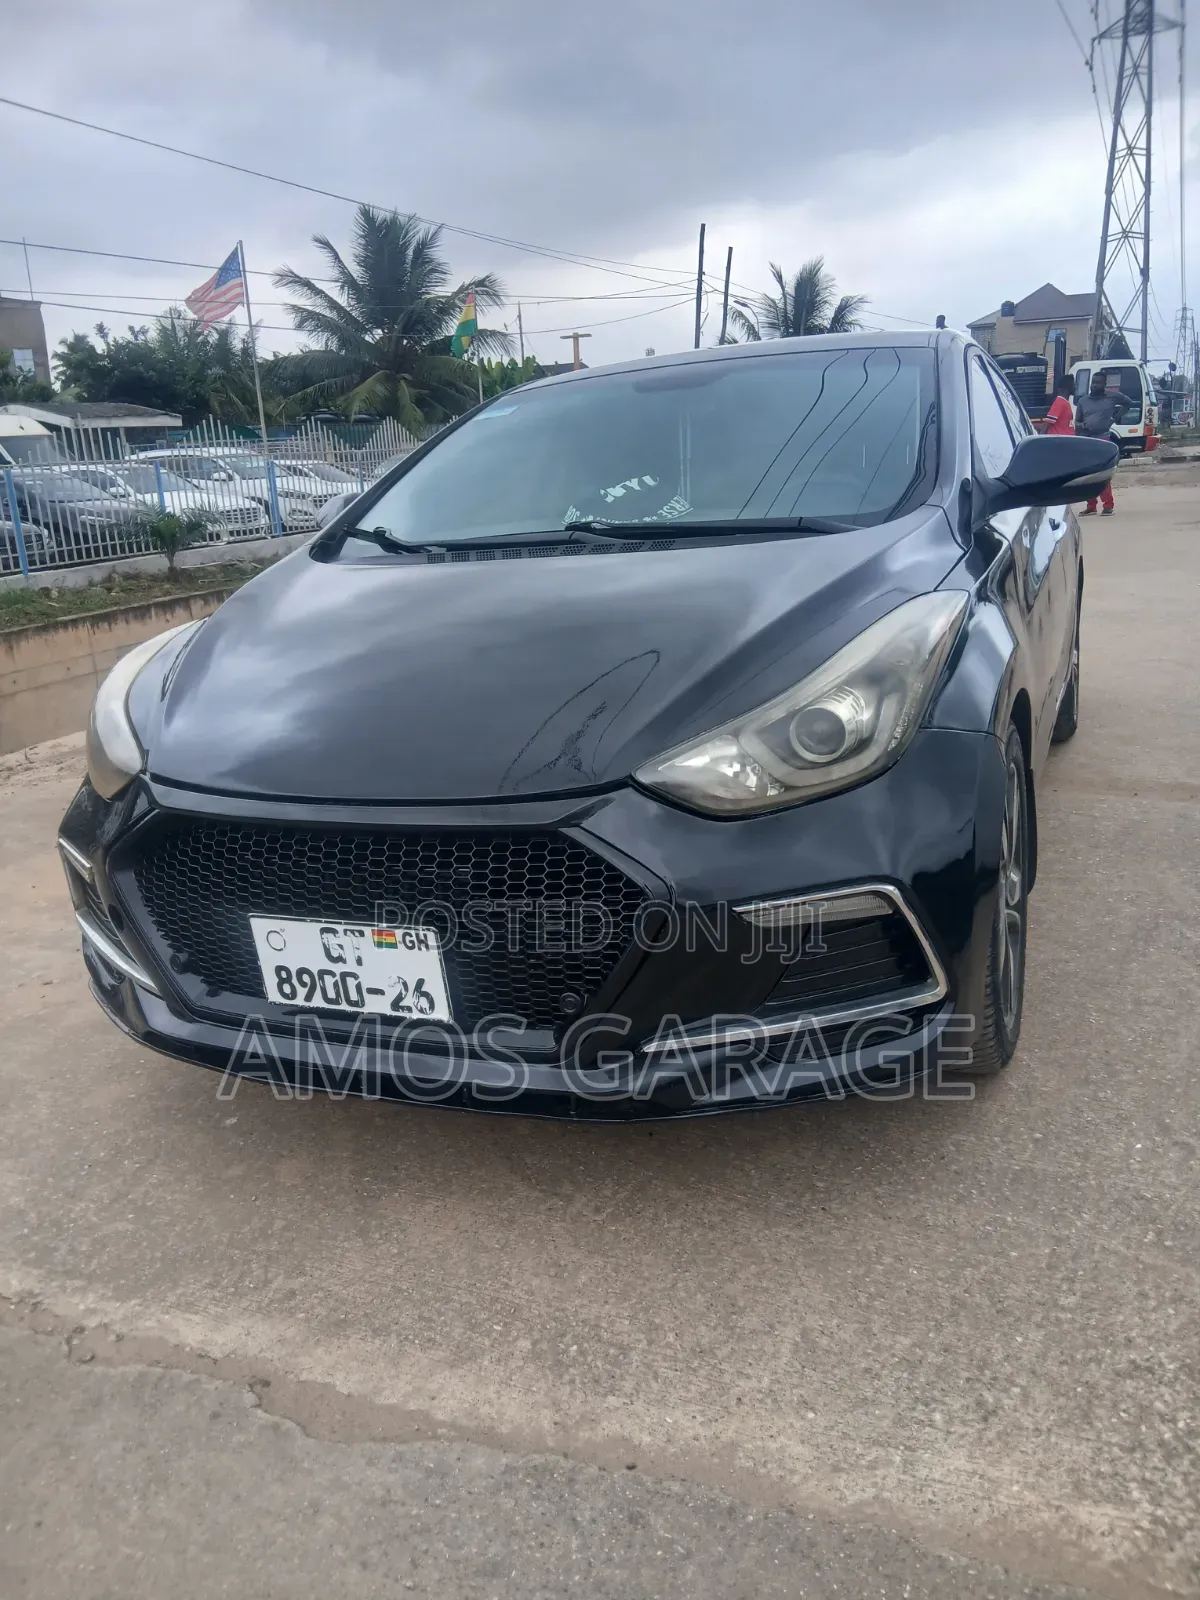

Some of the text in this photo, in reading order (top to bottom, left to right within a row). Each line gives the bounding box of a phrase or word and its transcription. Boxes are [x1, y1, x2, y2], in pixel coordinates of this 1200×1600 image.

[319, 926, 366, 967] GT
[400, 930, 430, 952] GH
[273, 963, 436, 1016] 8900-26
